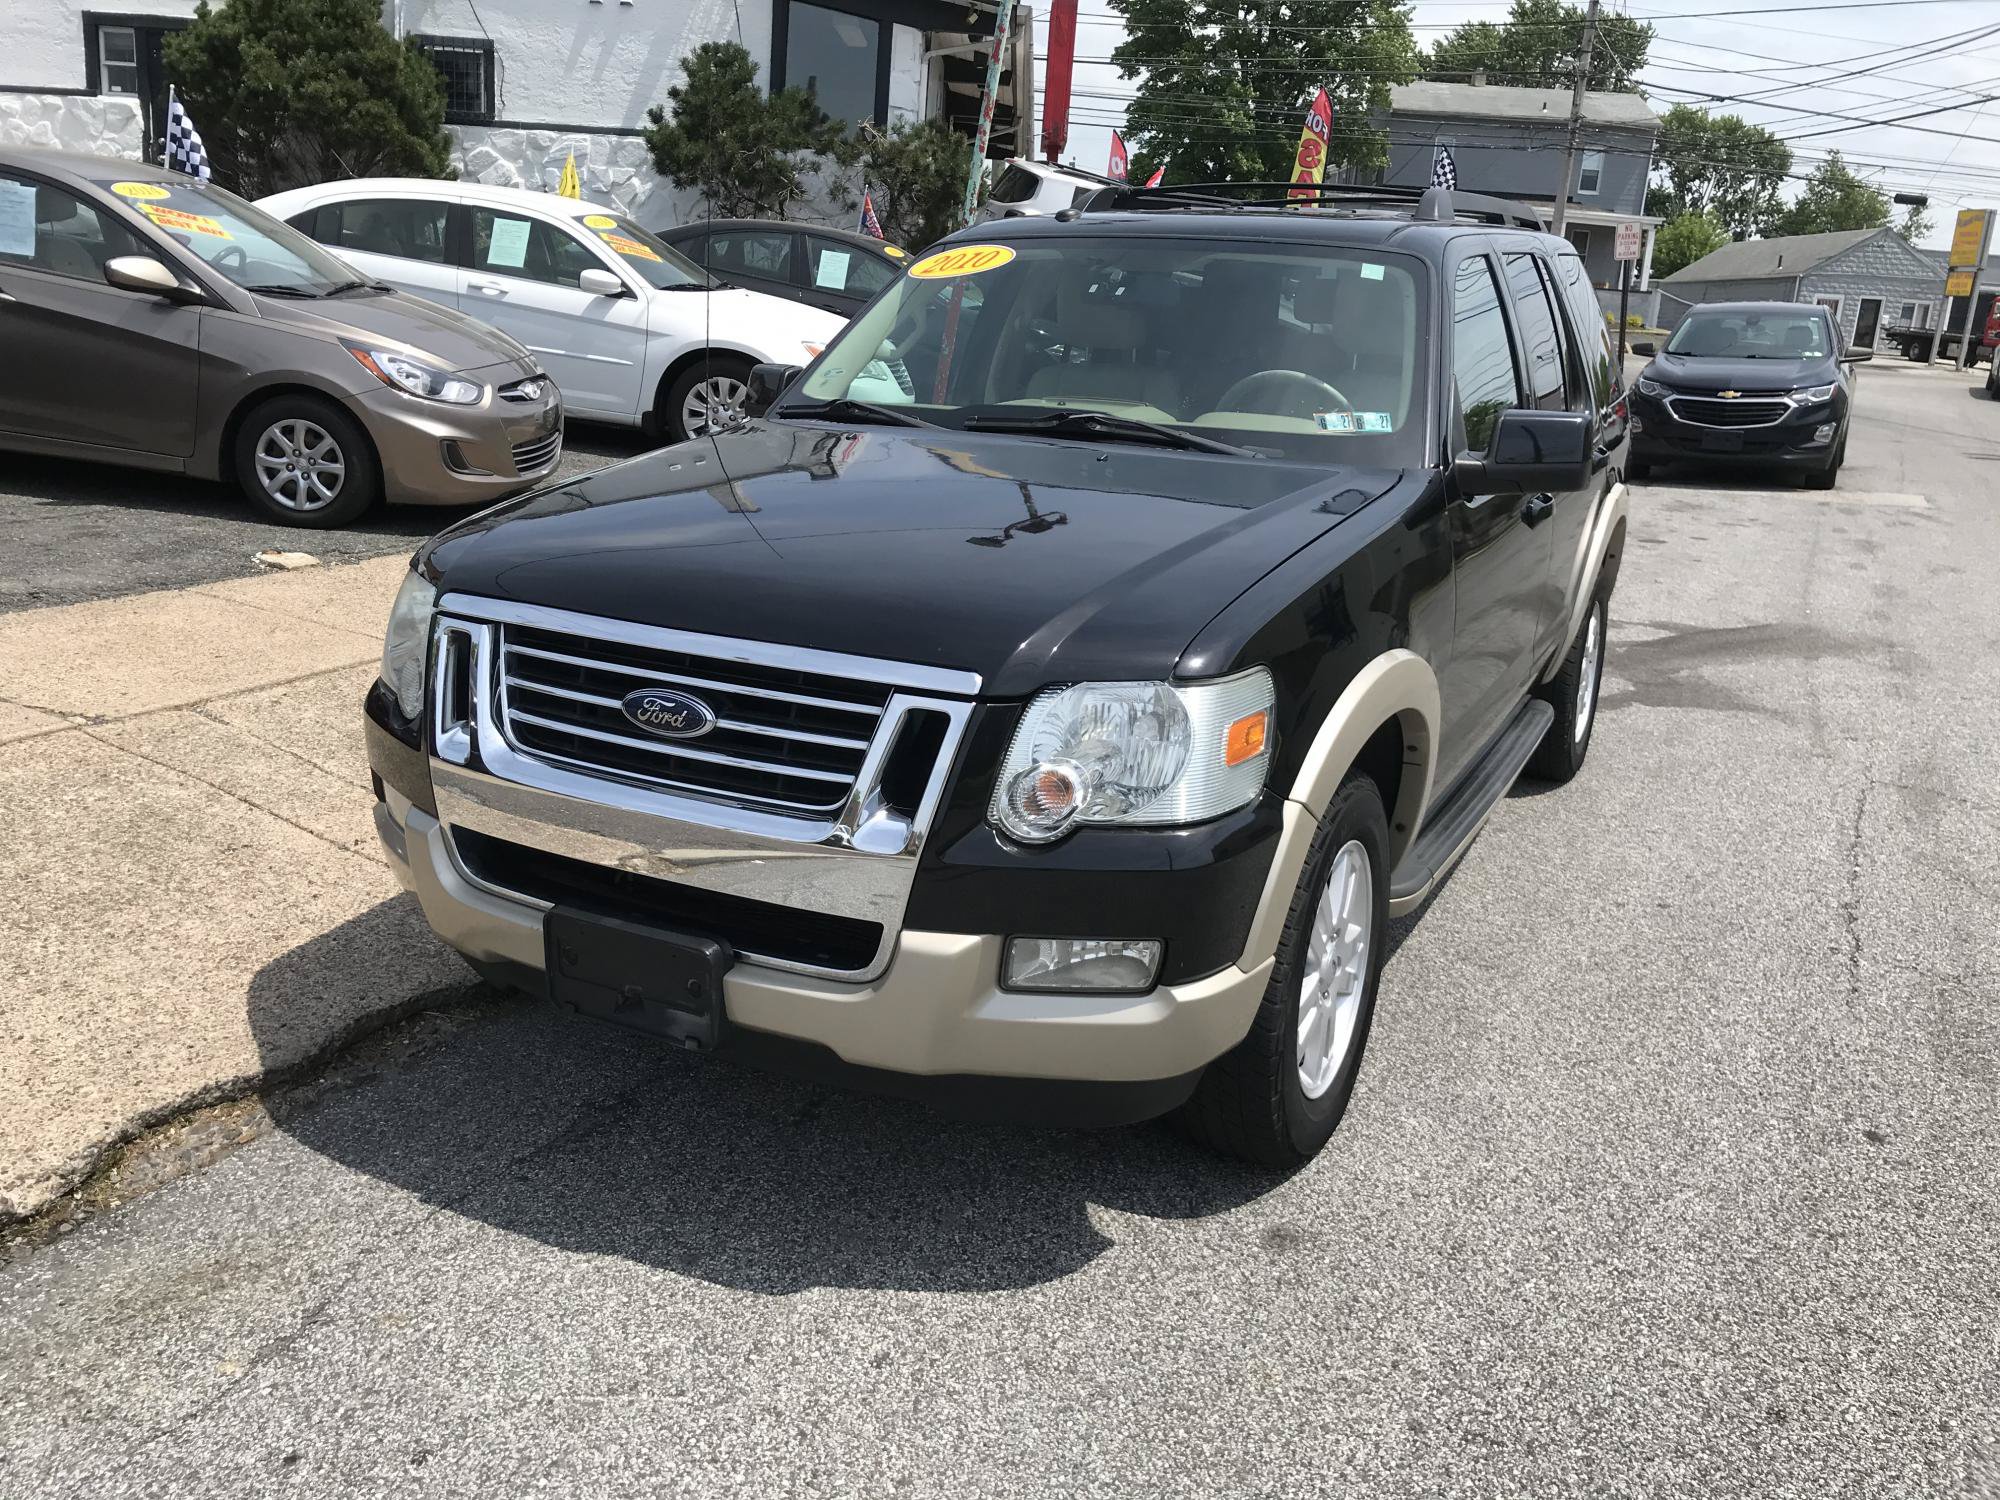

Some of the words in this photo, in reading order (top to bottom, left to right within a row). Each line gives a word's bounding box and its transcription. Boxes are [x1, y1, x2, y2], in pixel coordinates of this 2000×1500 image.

[1624, 223, 1633, 233] NO
[1616, 231, 1639, 241] PARKING
[919, 250, 1001, 275] 2010
[1320, 416, 1328, 430] 6
[1379, 415, 1390, 429] 27
[637, 697, 688, 728] Ford
